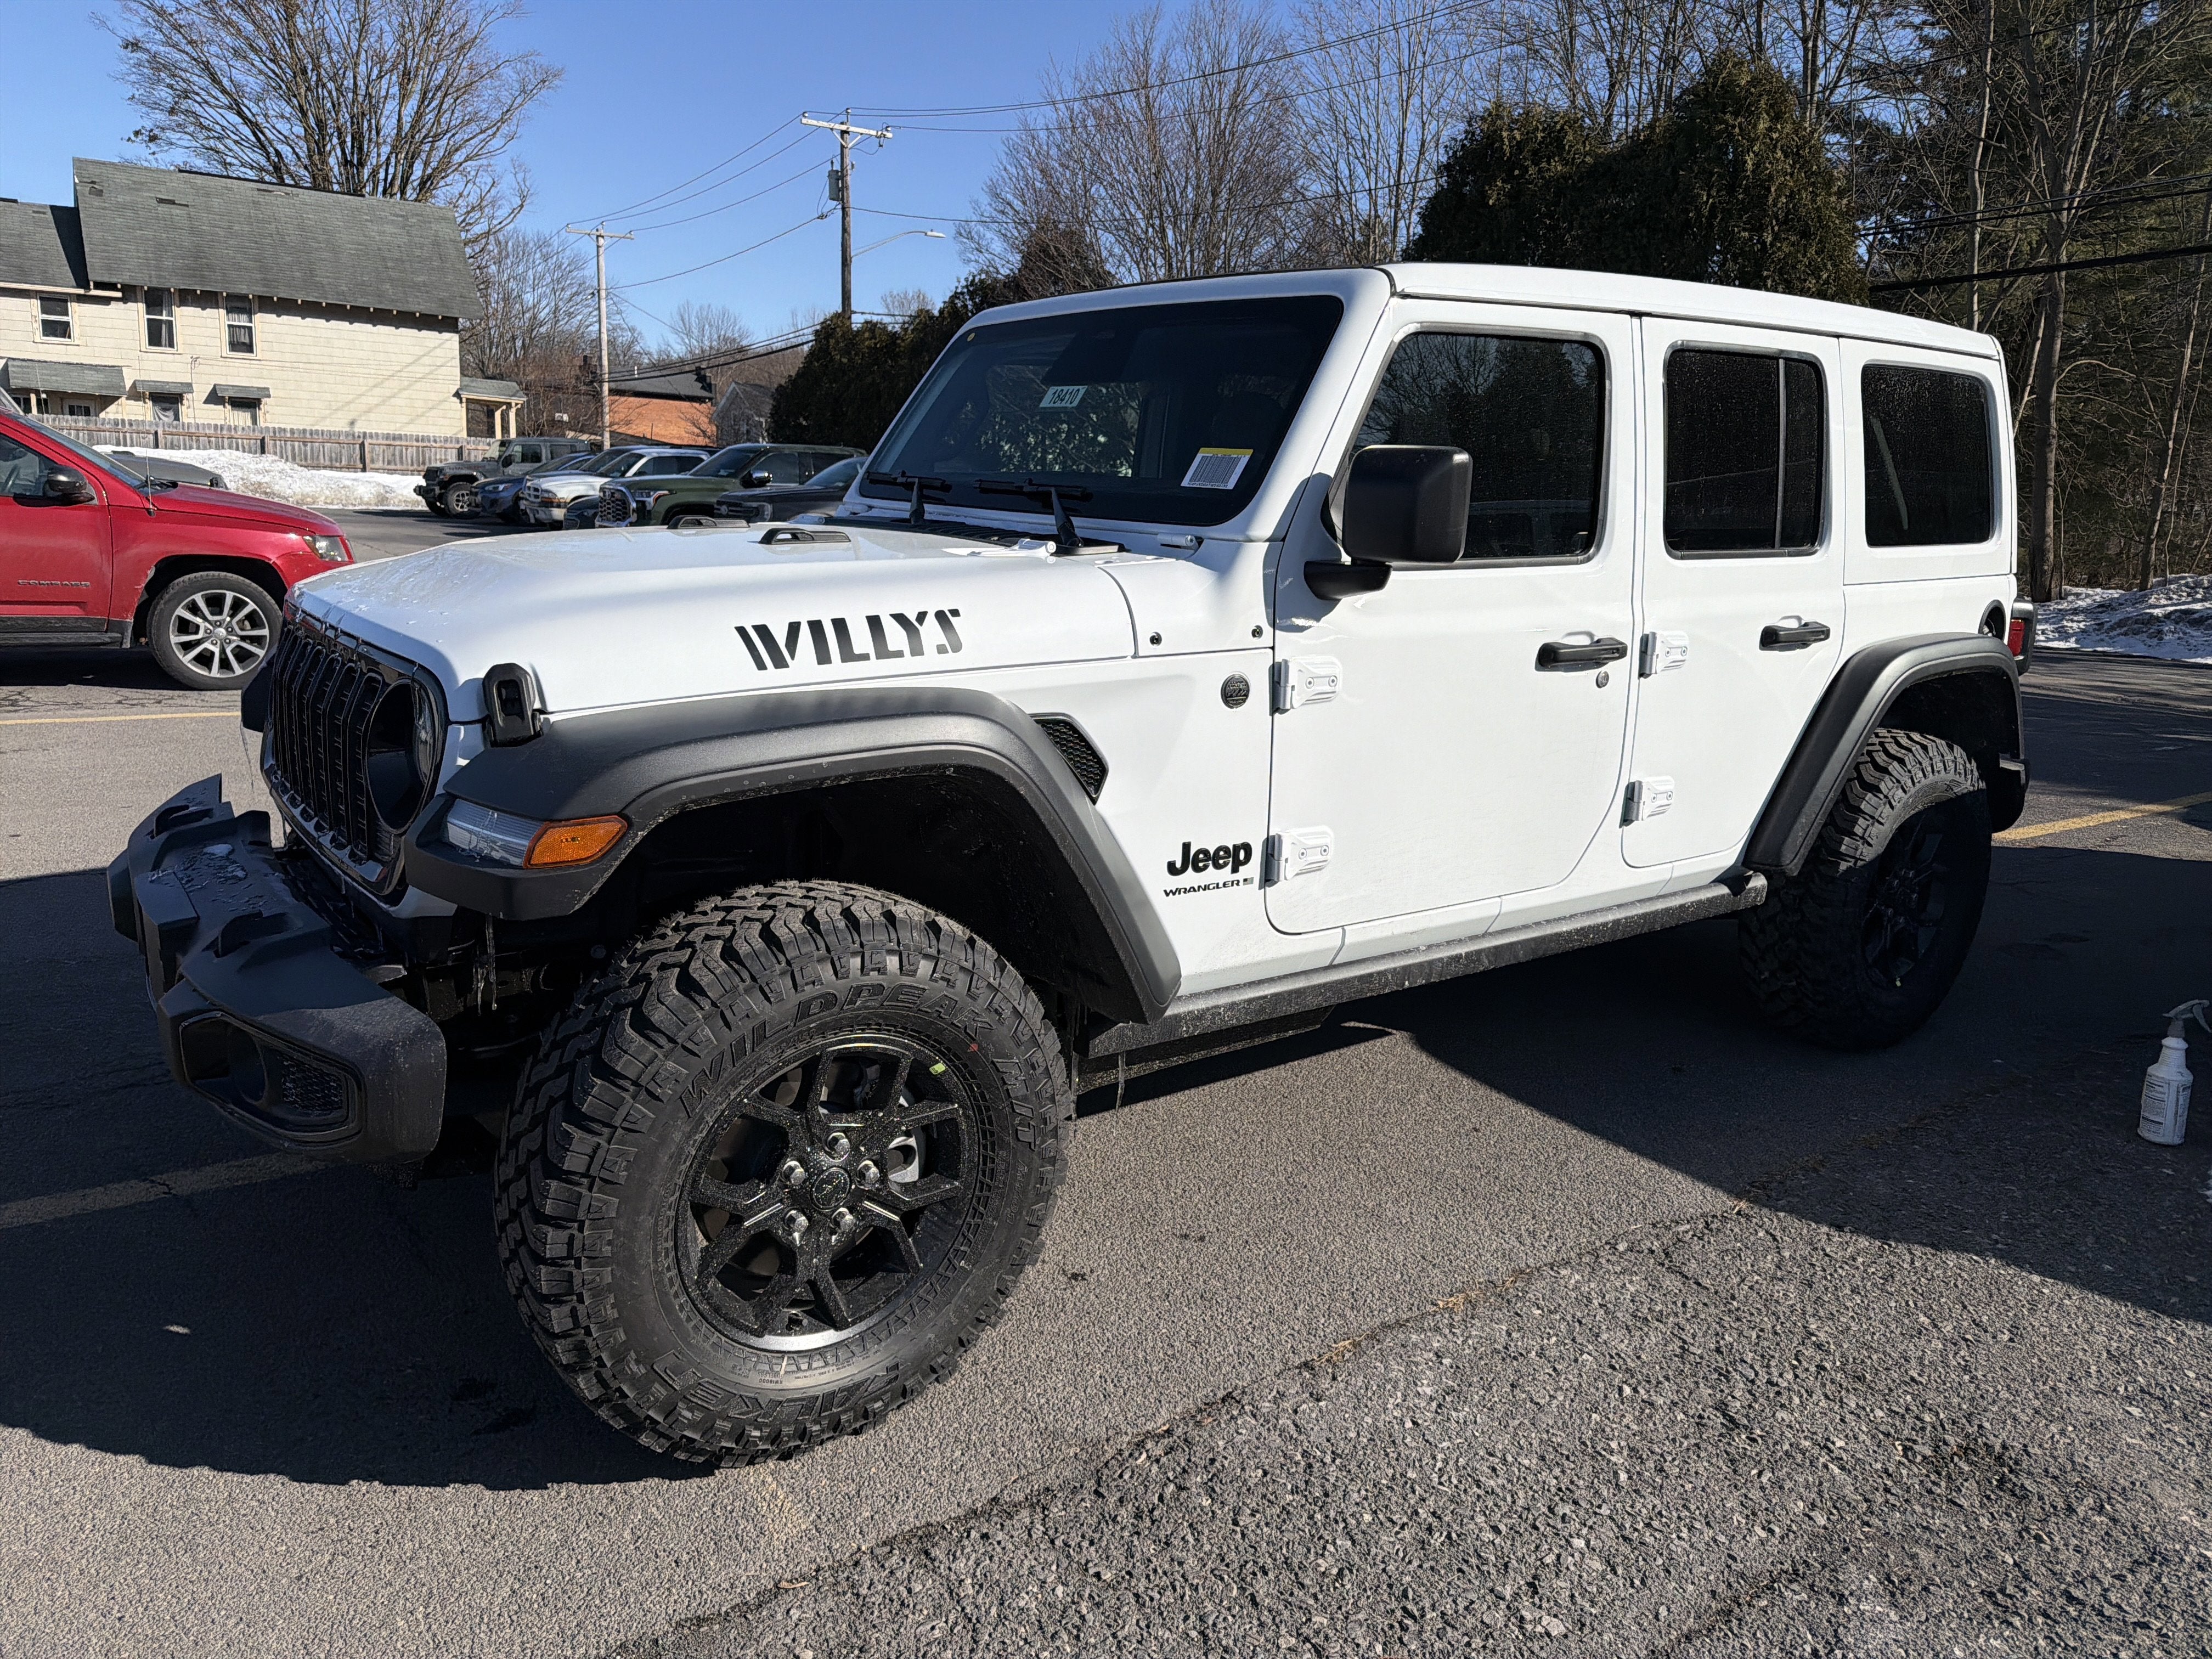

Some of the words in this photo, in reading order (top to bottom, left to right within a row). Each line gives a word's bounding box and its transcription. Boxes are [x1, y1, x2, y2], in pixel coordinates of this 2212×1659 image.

[1048, 388, 1080, 405] 18410
[17, 579, 90, 588] COMPASS
[734, 608, 963, 671] WILLYS
[1166, 841, 1253, 877] Jeep
[1163, 879, 1241, 898] WRANGLER
[679, 981, 997, 1118] WILDPEAK
[652, 1350, 900, 1424] FALKEN
